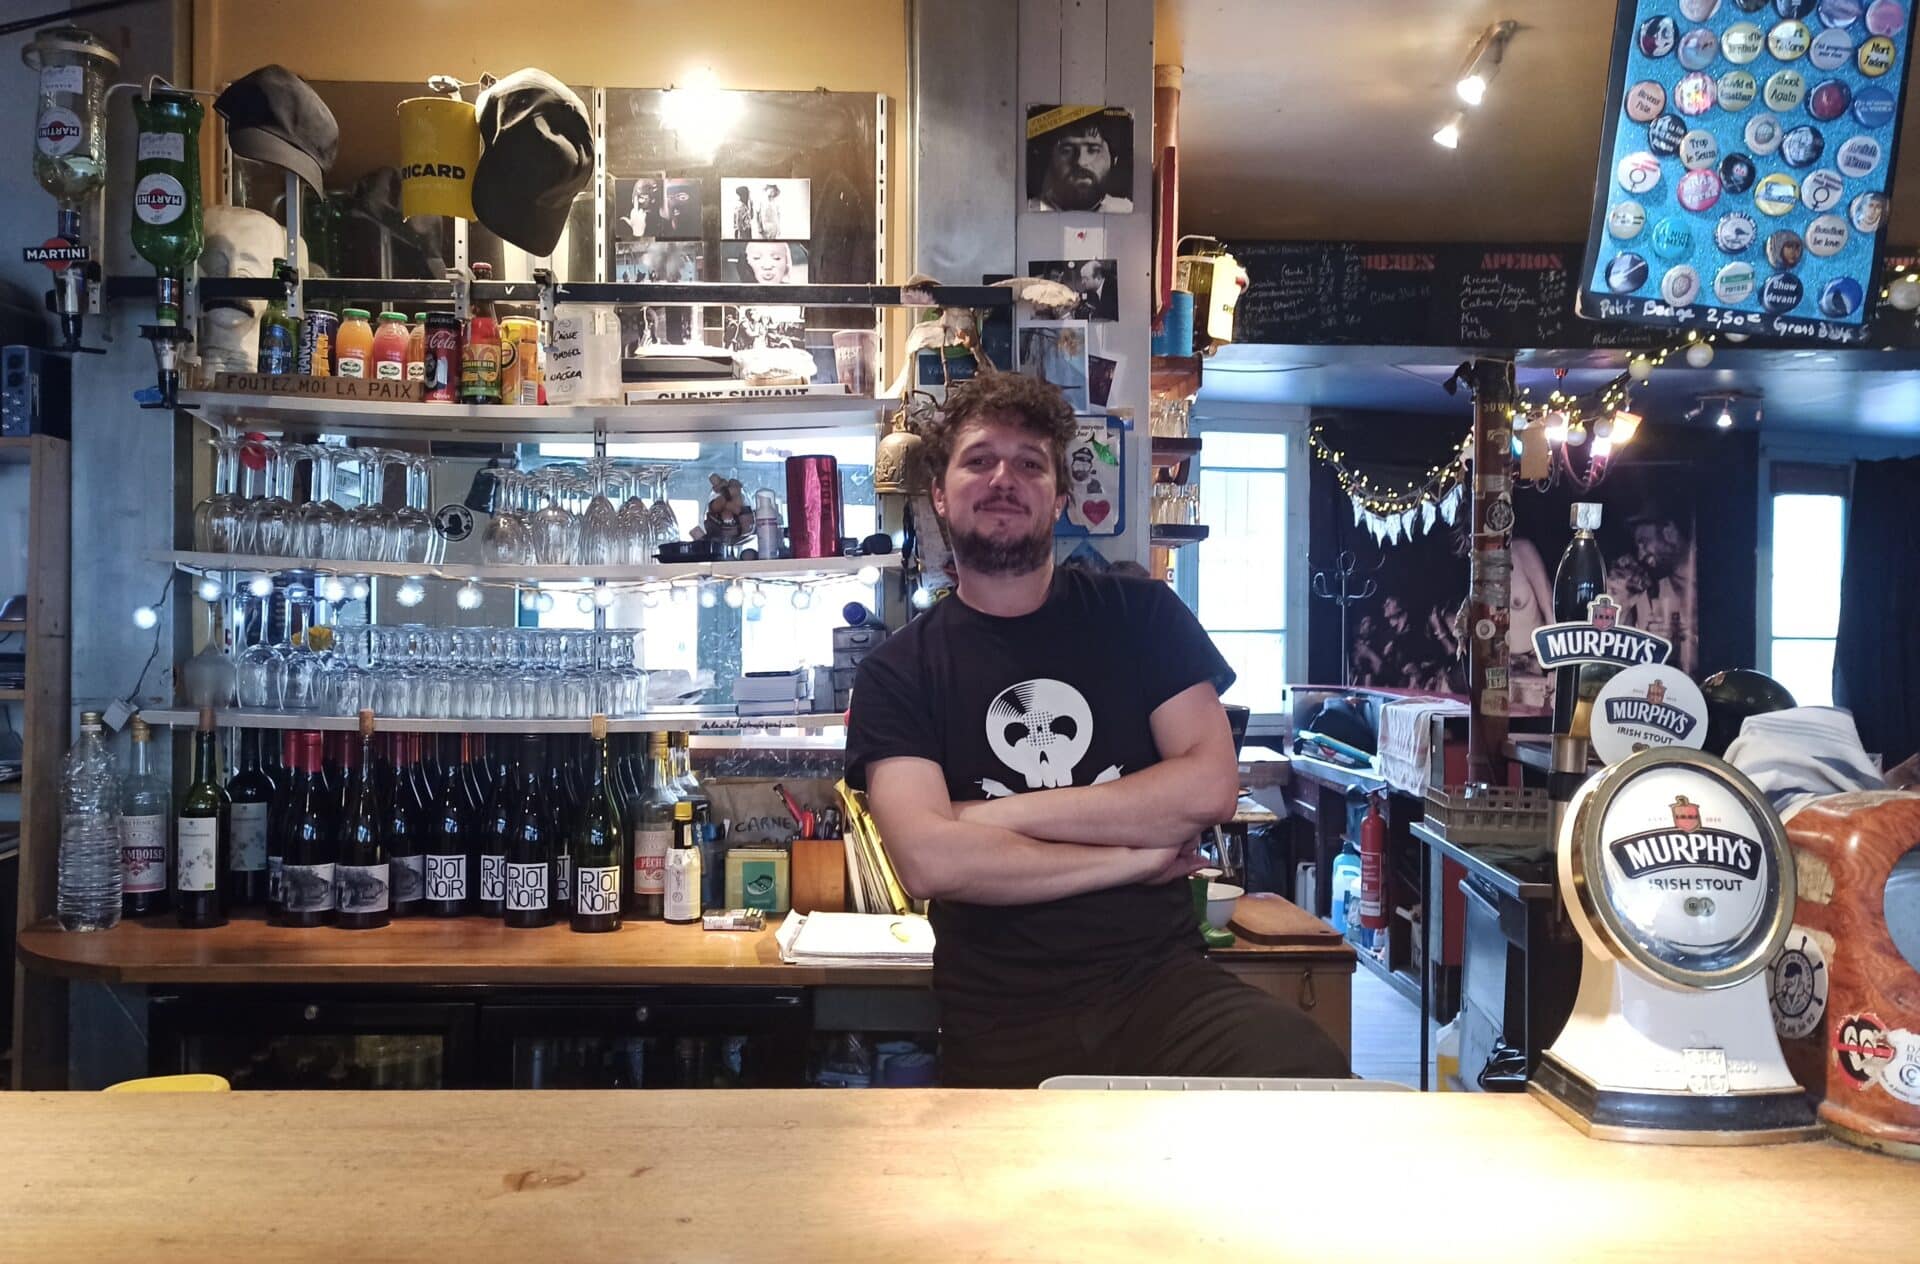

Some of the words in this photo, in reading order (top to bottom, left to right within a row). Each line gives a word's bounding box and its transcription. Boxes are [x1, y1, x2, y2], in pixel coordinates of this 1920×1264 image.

[1770, 88, 1797, 103] Again
[39, 127, 79, 136] MARTINI
[137, 195, 182, 205] MARTINI
[26, 247, 86, 260] MARTINI
[1773, 280, 1798, 291] Show
[1767, 293, 1797, 305] devant
[1643, 300, 1695, 323] Badge
[336, 382, 357, 396] LA
[368, 382, 412, 399] PAIX
[1547, 630, 1657, 665] MURPHY'S
[1612, 701, 1690, 735] MURPHY'S
[1616, 726, 1643, 739] IRISH
[1643, 729, 1674, 745] STOUT
[1623, 833, 1752, 871] MURPHY'S
[1695, 878, 1744, 892] STOUT
